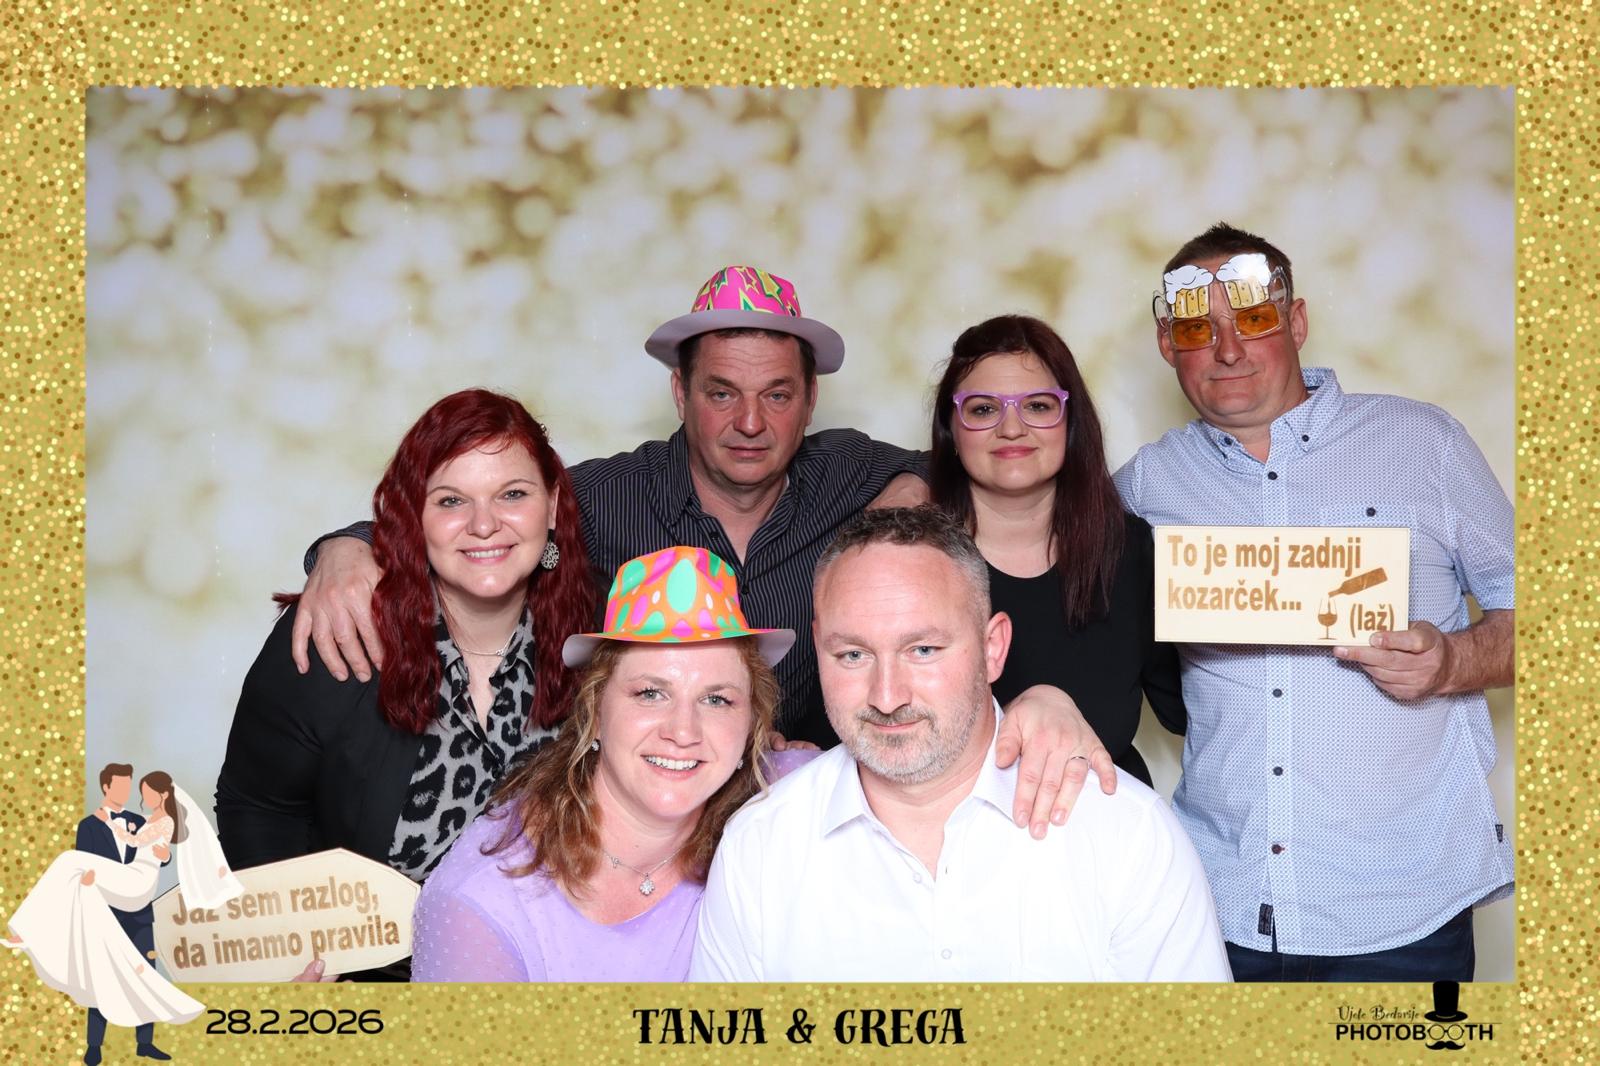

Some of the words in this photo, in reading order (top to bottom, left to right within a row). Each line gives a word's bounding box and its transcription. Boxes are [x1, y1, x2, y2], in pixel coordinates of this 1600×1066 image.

[1167, 535, 1198, 567] To
[1204, 536, 1227, 575] je
[1235, 536, 1279, 576] moj
[1287, 537, 1361, 577] zadnji
[1167, 577, 1302, 611] kozarček...
[1349, 603, 1395, 637] (laž)
[226, 888, 282, 920] sem
[289, 876, 378, 913] razlog,
[173, 936, 207, 969] da
[213, 932, 303, 965] imamo
[310, 915, 400, 960] pravila
